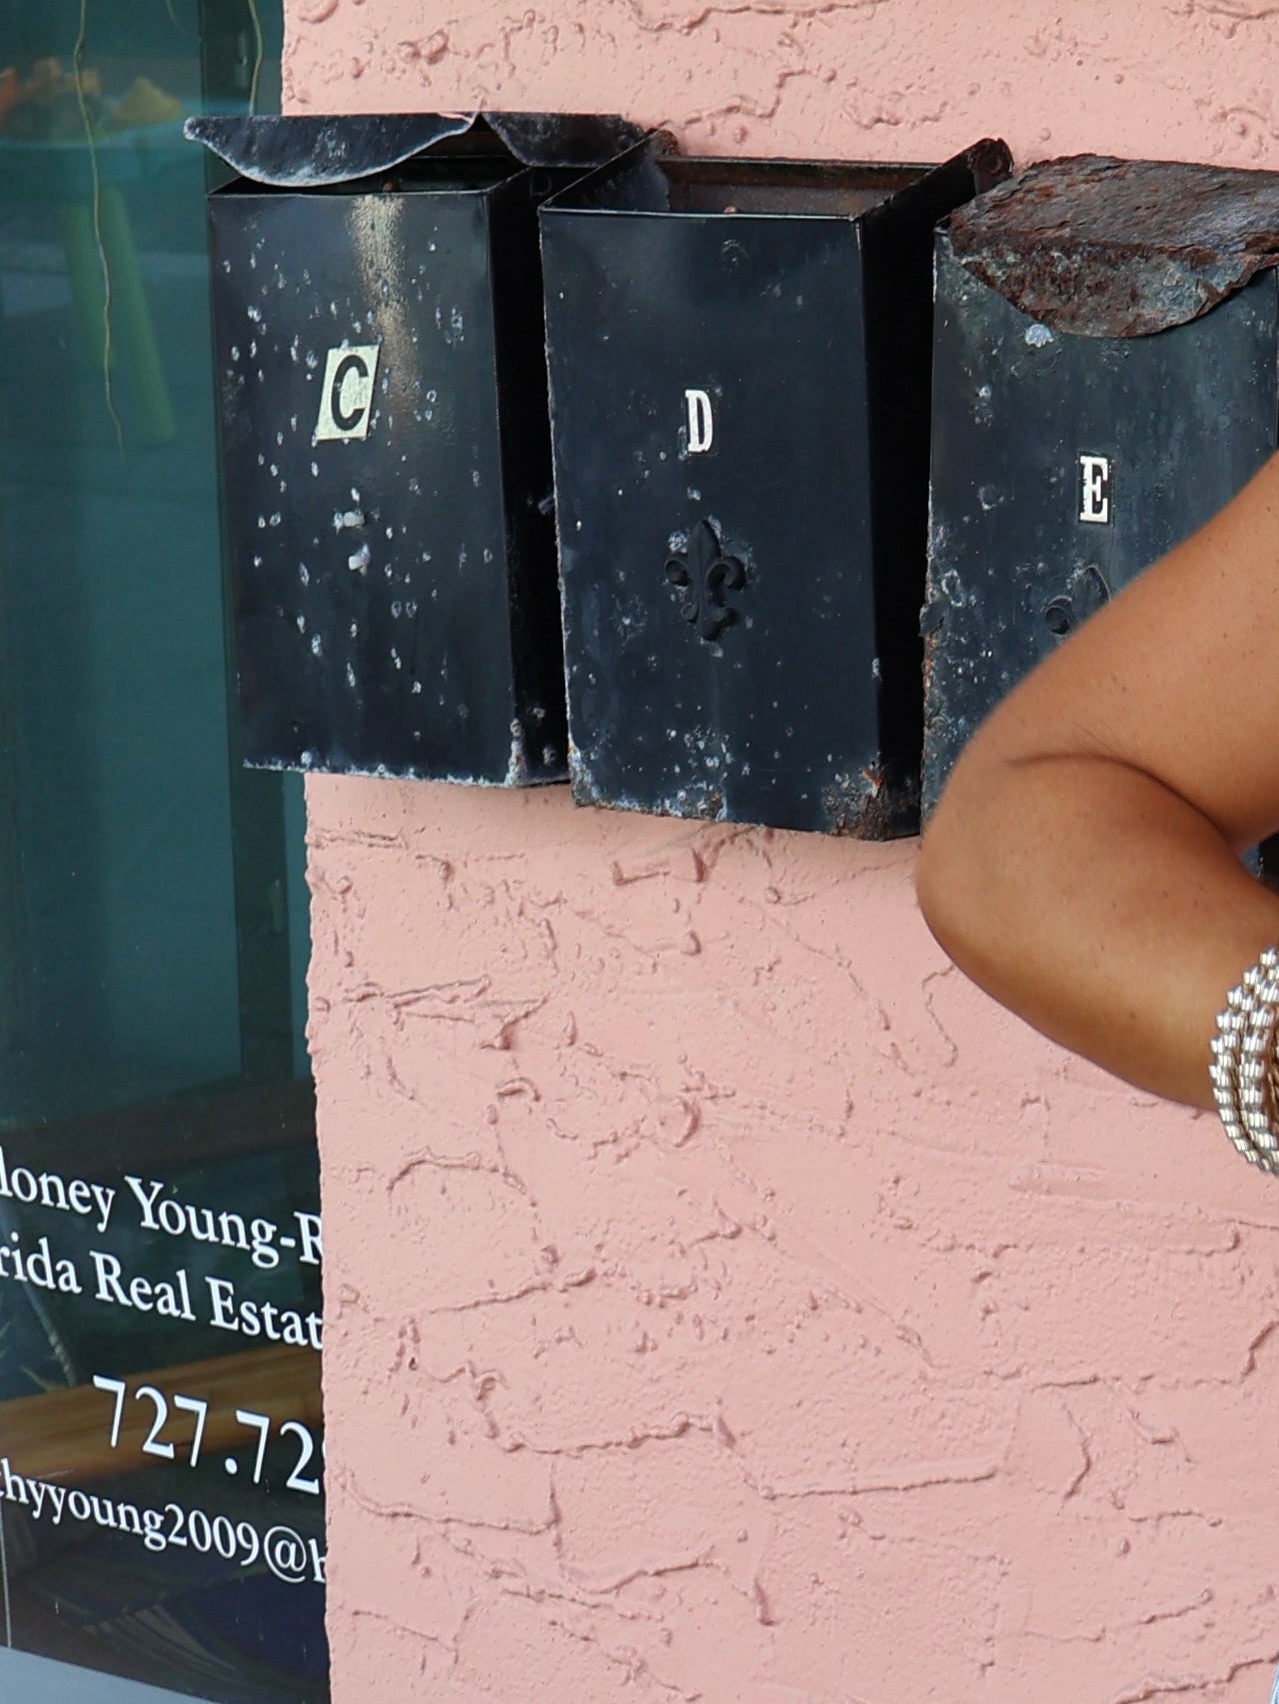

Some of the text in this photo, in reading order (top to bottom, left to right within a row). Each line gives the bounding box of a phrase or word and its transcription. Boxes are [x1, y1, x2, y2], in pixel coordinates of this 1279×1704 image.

[331, 354, 369, 431] C
[685, 389, 713, 453] D
[1079, 455, 1109, 523] E
[89, 1250, 195, 1321] Real
[93, 1375, 325, 1494] 727.72
